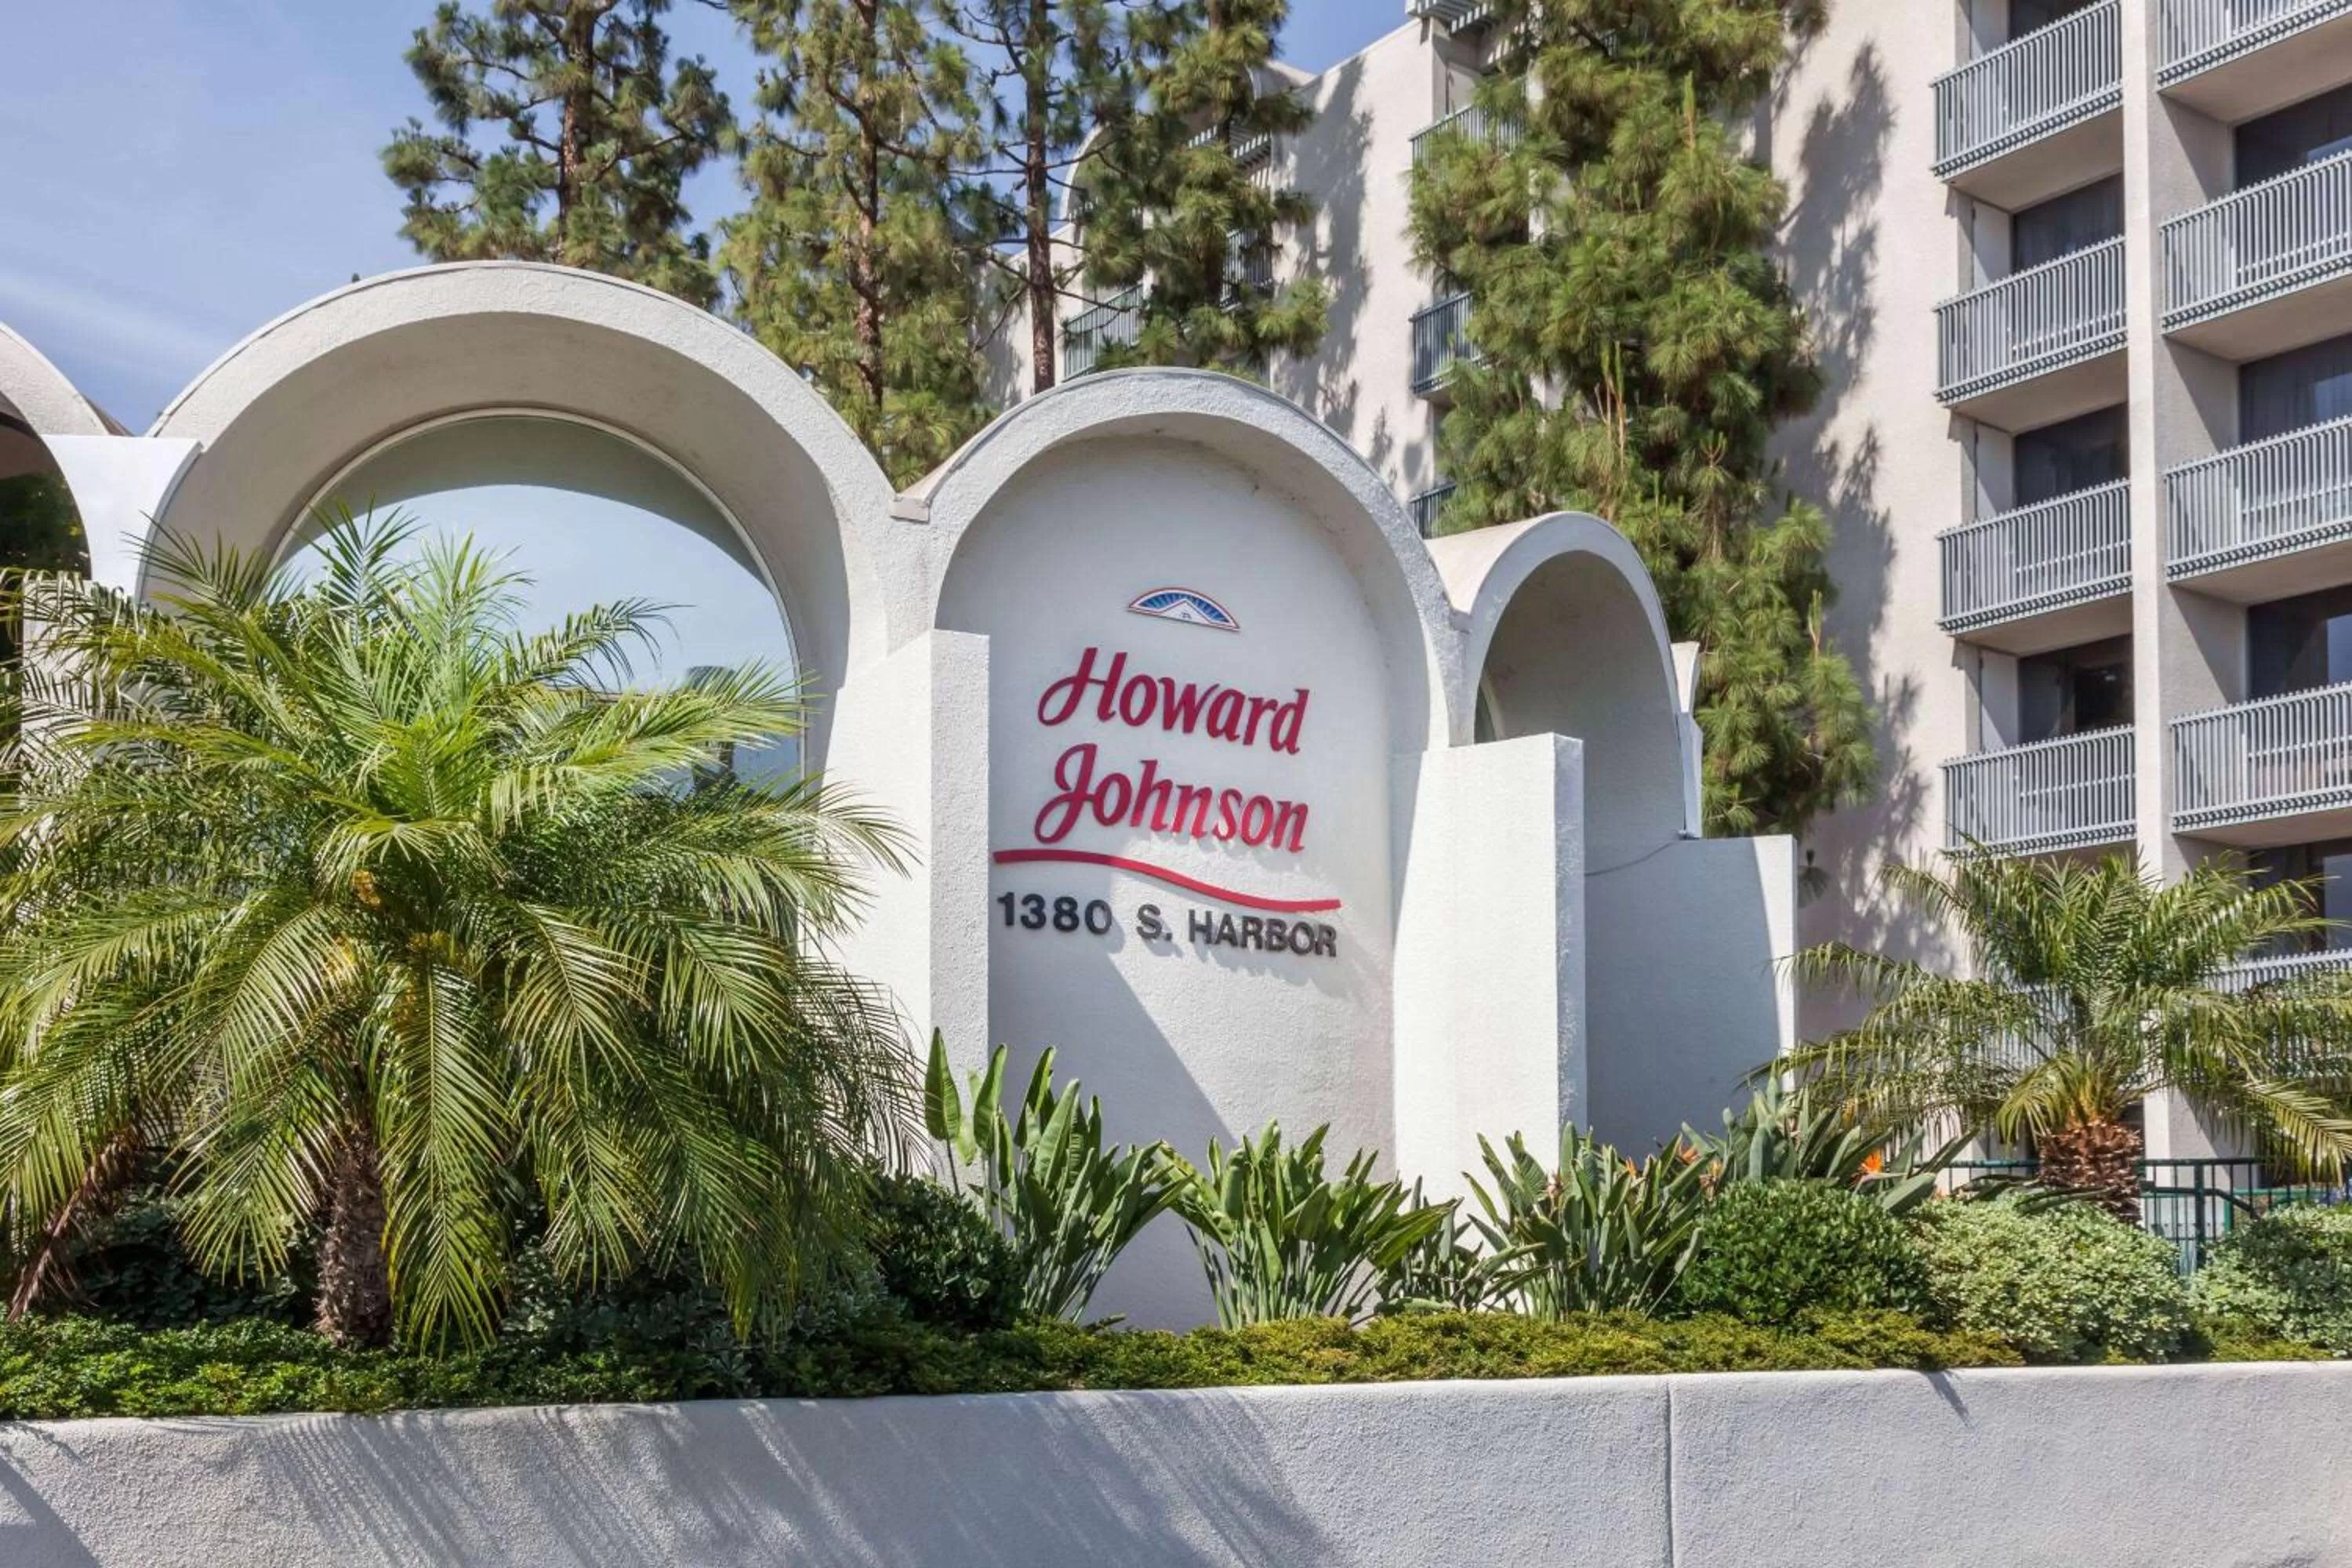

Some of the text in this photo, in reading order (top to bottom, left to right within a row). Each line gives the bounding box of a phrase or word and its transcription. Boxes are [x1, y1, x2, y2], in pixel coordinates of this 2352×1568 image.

[1038, 647, 1309, 755] Howard
[1034, 743, 1309, 853] Johnson
[996, 892, 1338, 956] 1380 S. HARBOR
